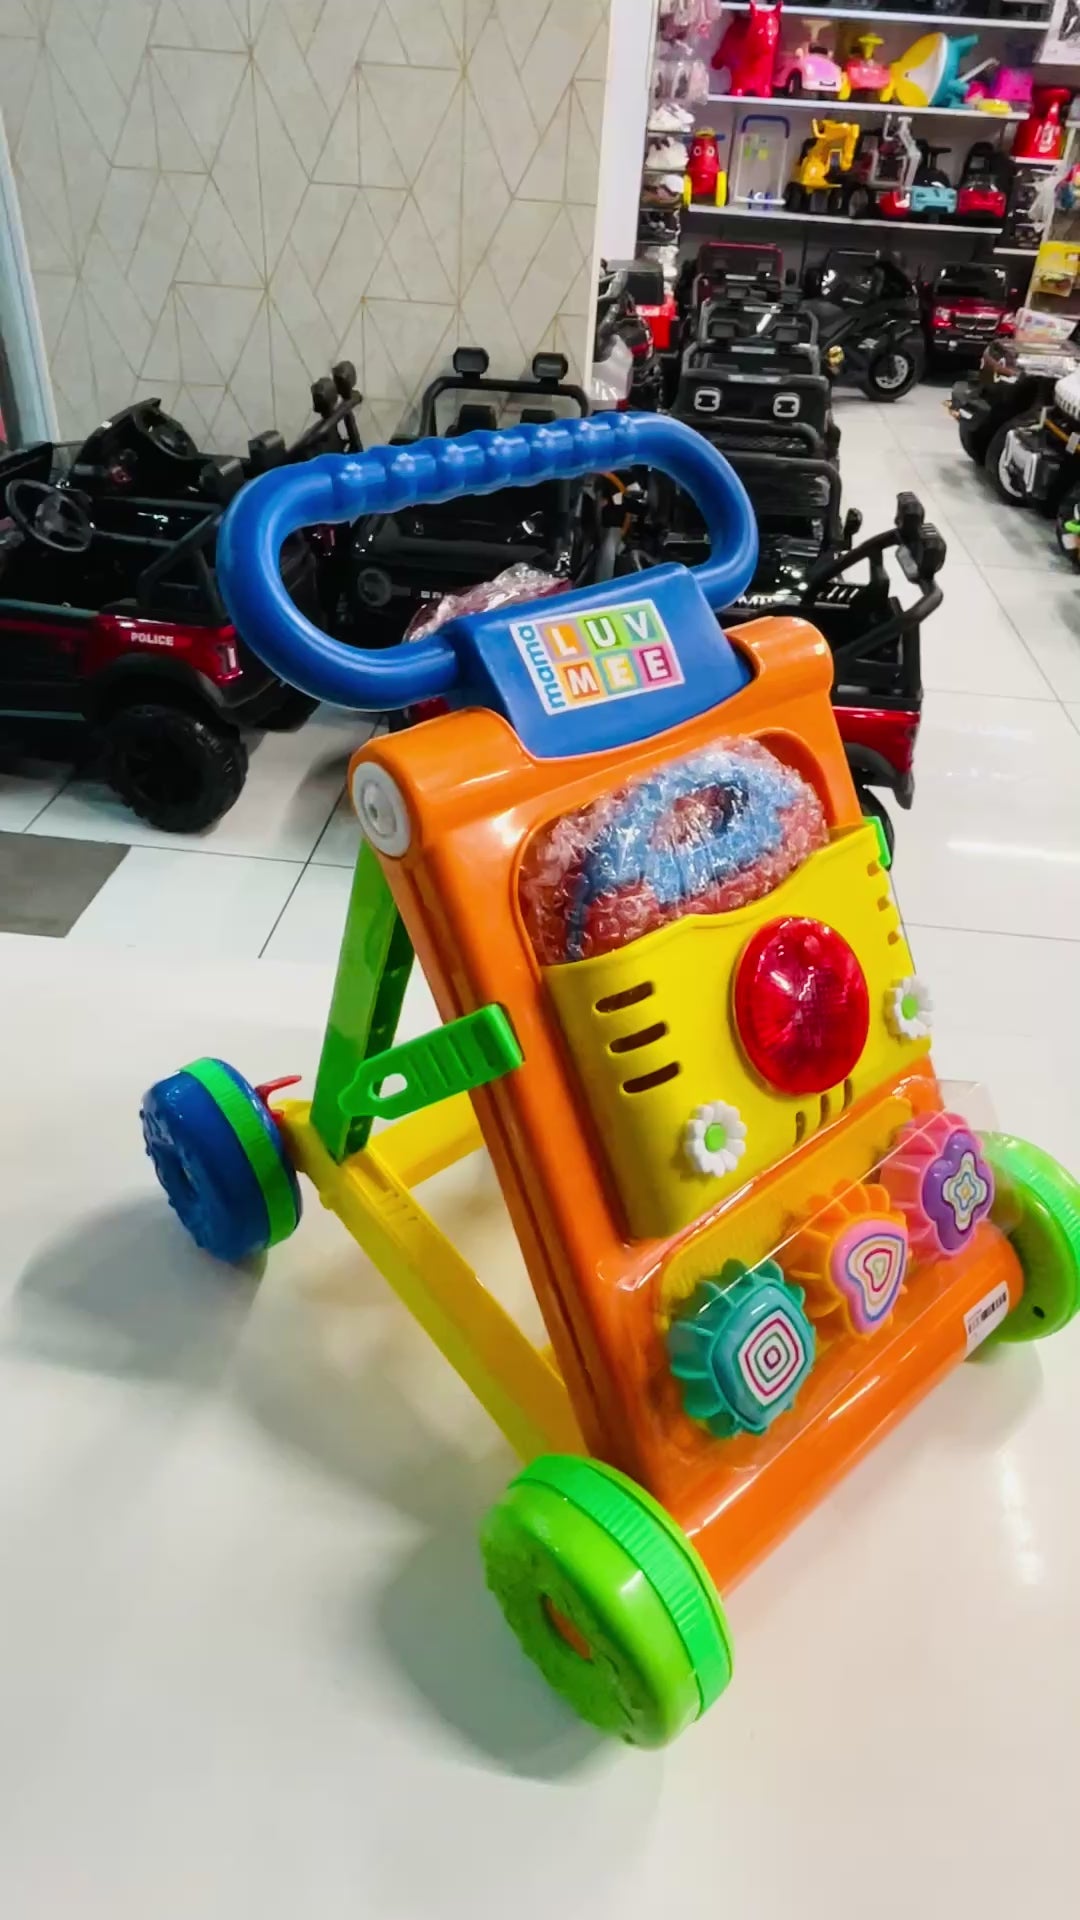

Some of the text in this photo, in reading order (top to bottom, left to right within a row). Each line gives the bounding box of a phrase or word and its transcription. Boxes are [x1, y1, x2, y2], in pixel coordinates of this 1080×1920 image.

[130, 632, 174, 647] POLICE
[551, 611, 649, 657] LUV
[518, 625, 566, 709] mama
[567, 649, 669, 696] MEE
